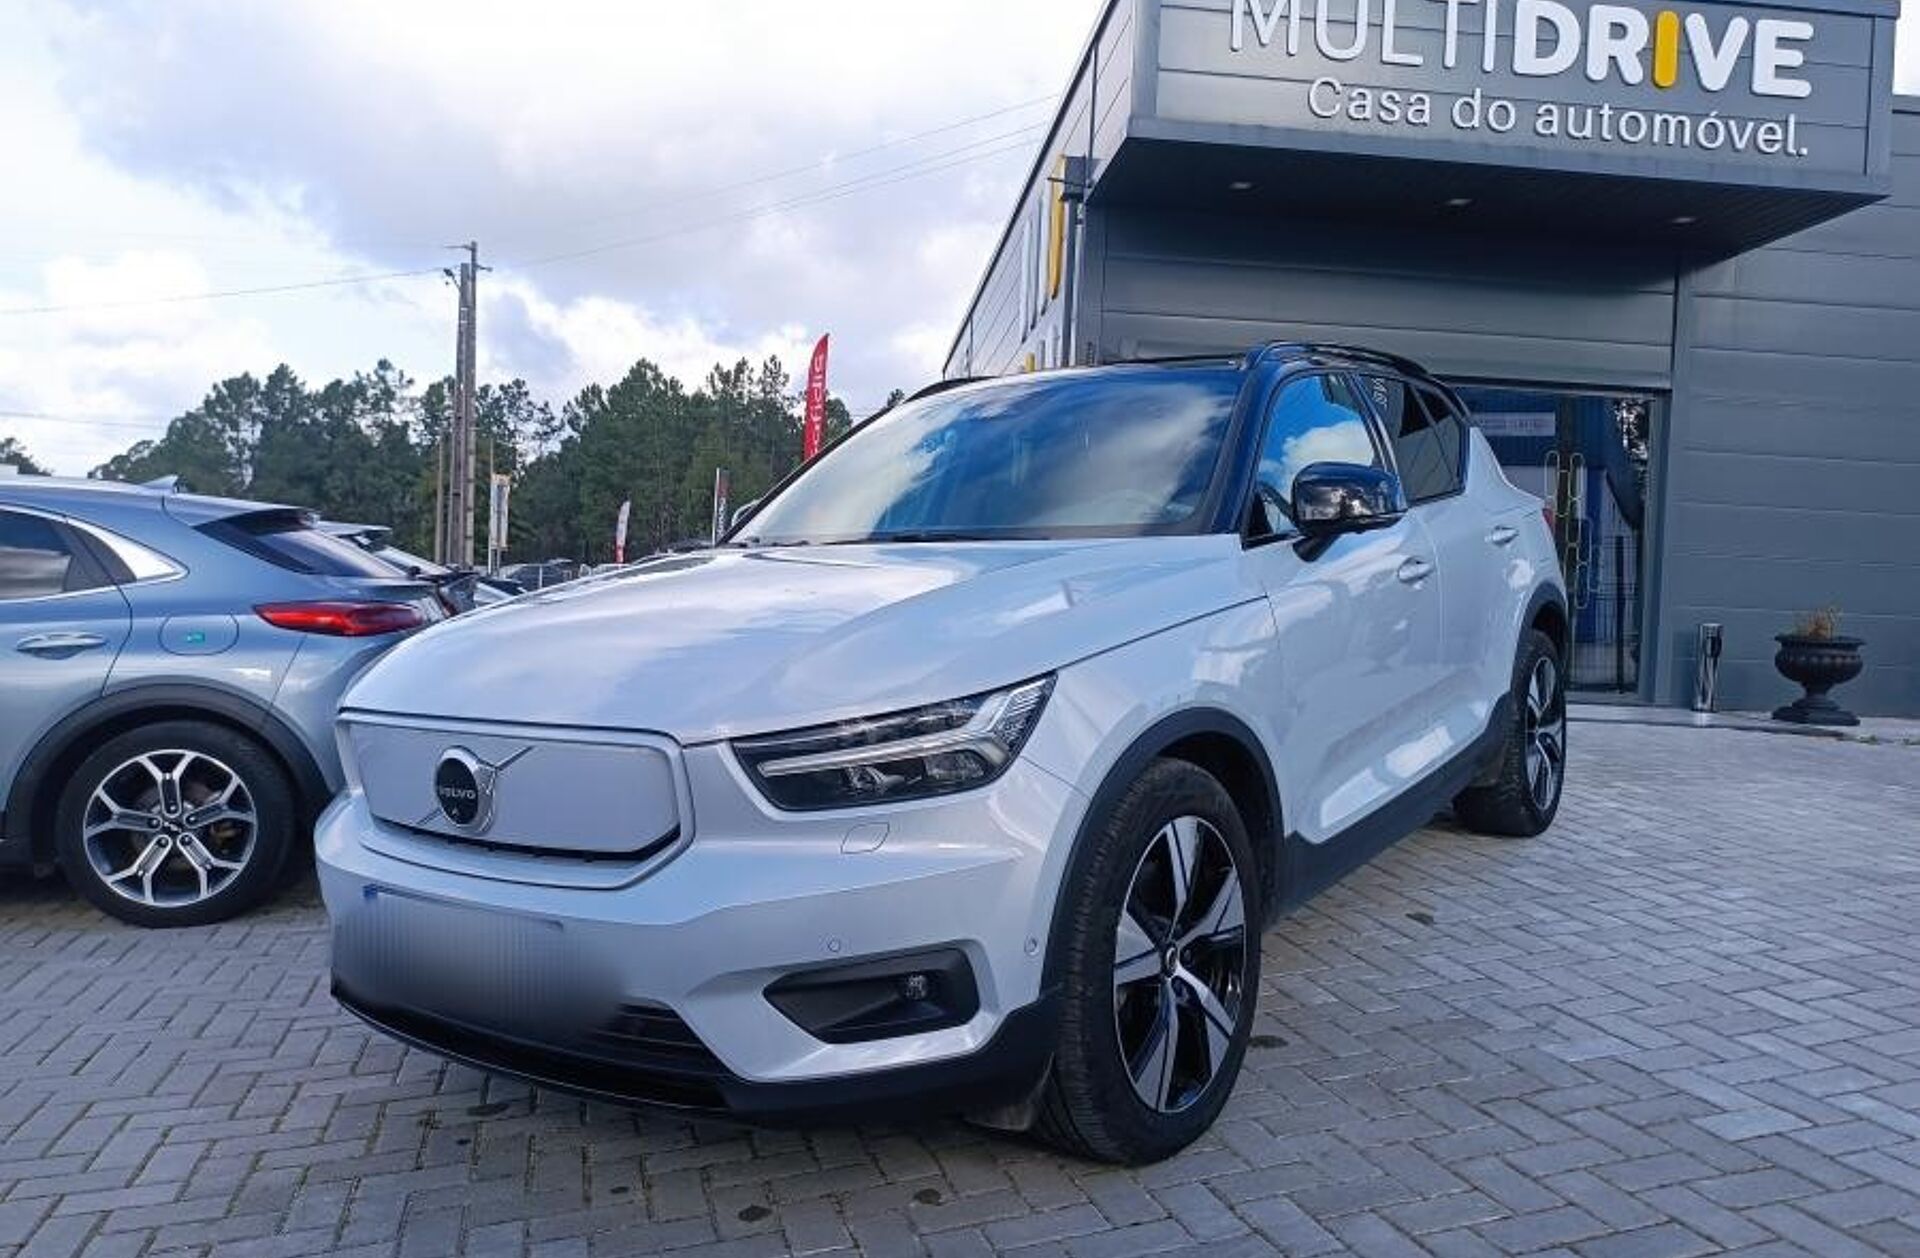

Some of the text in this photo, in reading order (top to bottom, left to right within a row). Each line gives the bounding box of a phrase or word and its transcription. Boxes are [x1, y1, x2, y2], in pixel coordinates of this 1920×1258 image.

[1230, 0, 1814, 97] MULTIDRIVE
[1308, 76, 1808, 155] Casa do automóvel.
